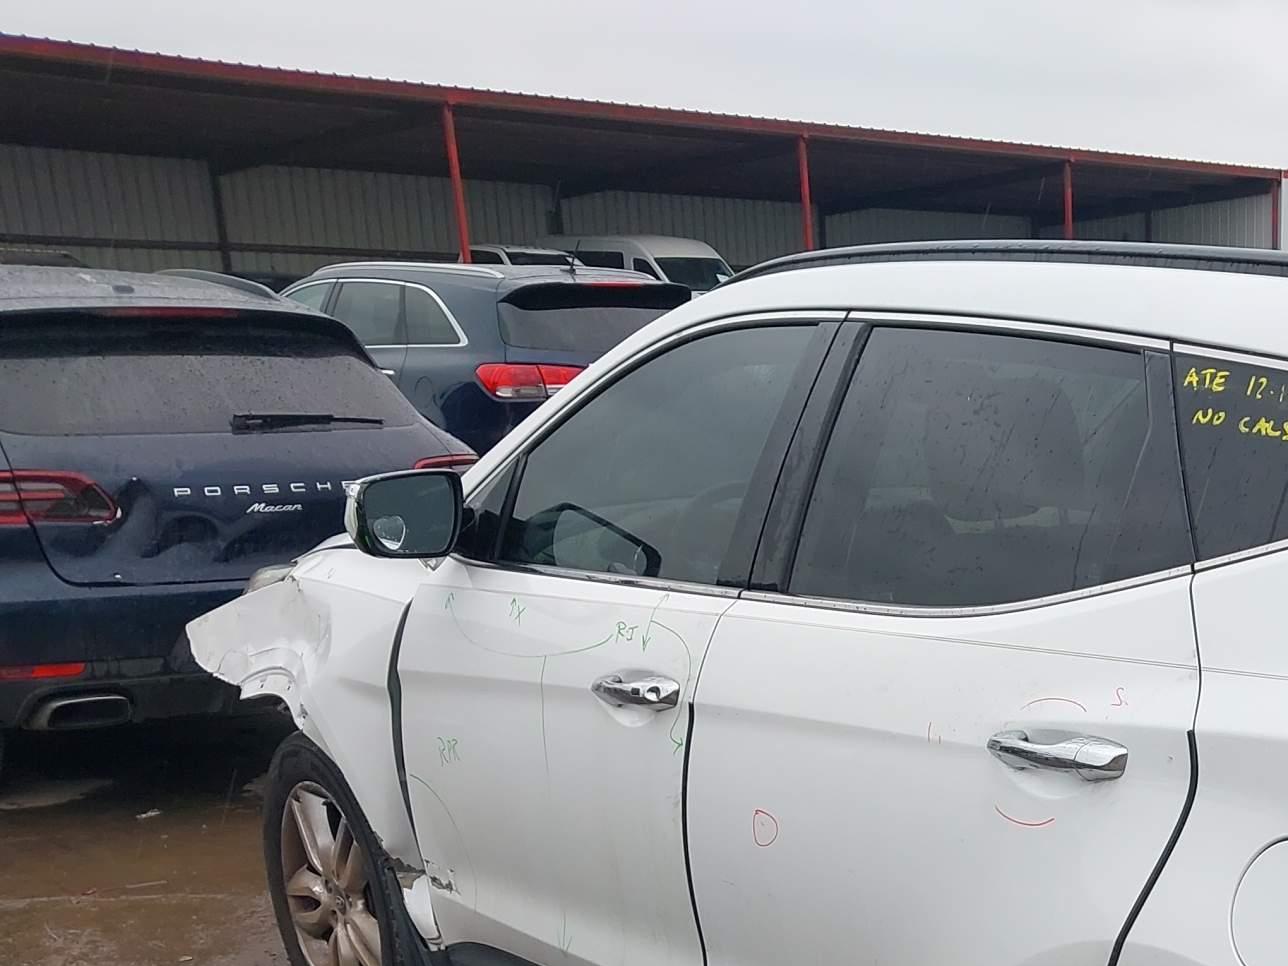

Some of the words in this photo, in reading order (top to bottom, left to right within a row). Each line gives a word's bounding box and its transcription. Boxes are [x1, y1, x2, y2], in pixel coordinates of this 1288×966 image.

[1183, 367, 1230, 393] ATE
[1192, 407, 1227, 426] NO
[246, 502, 303, 514] Macan
